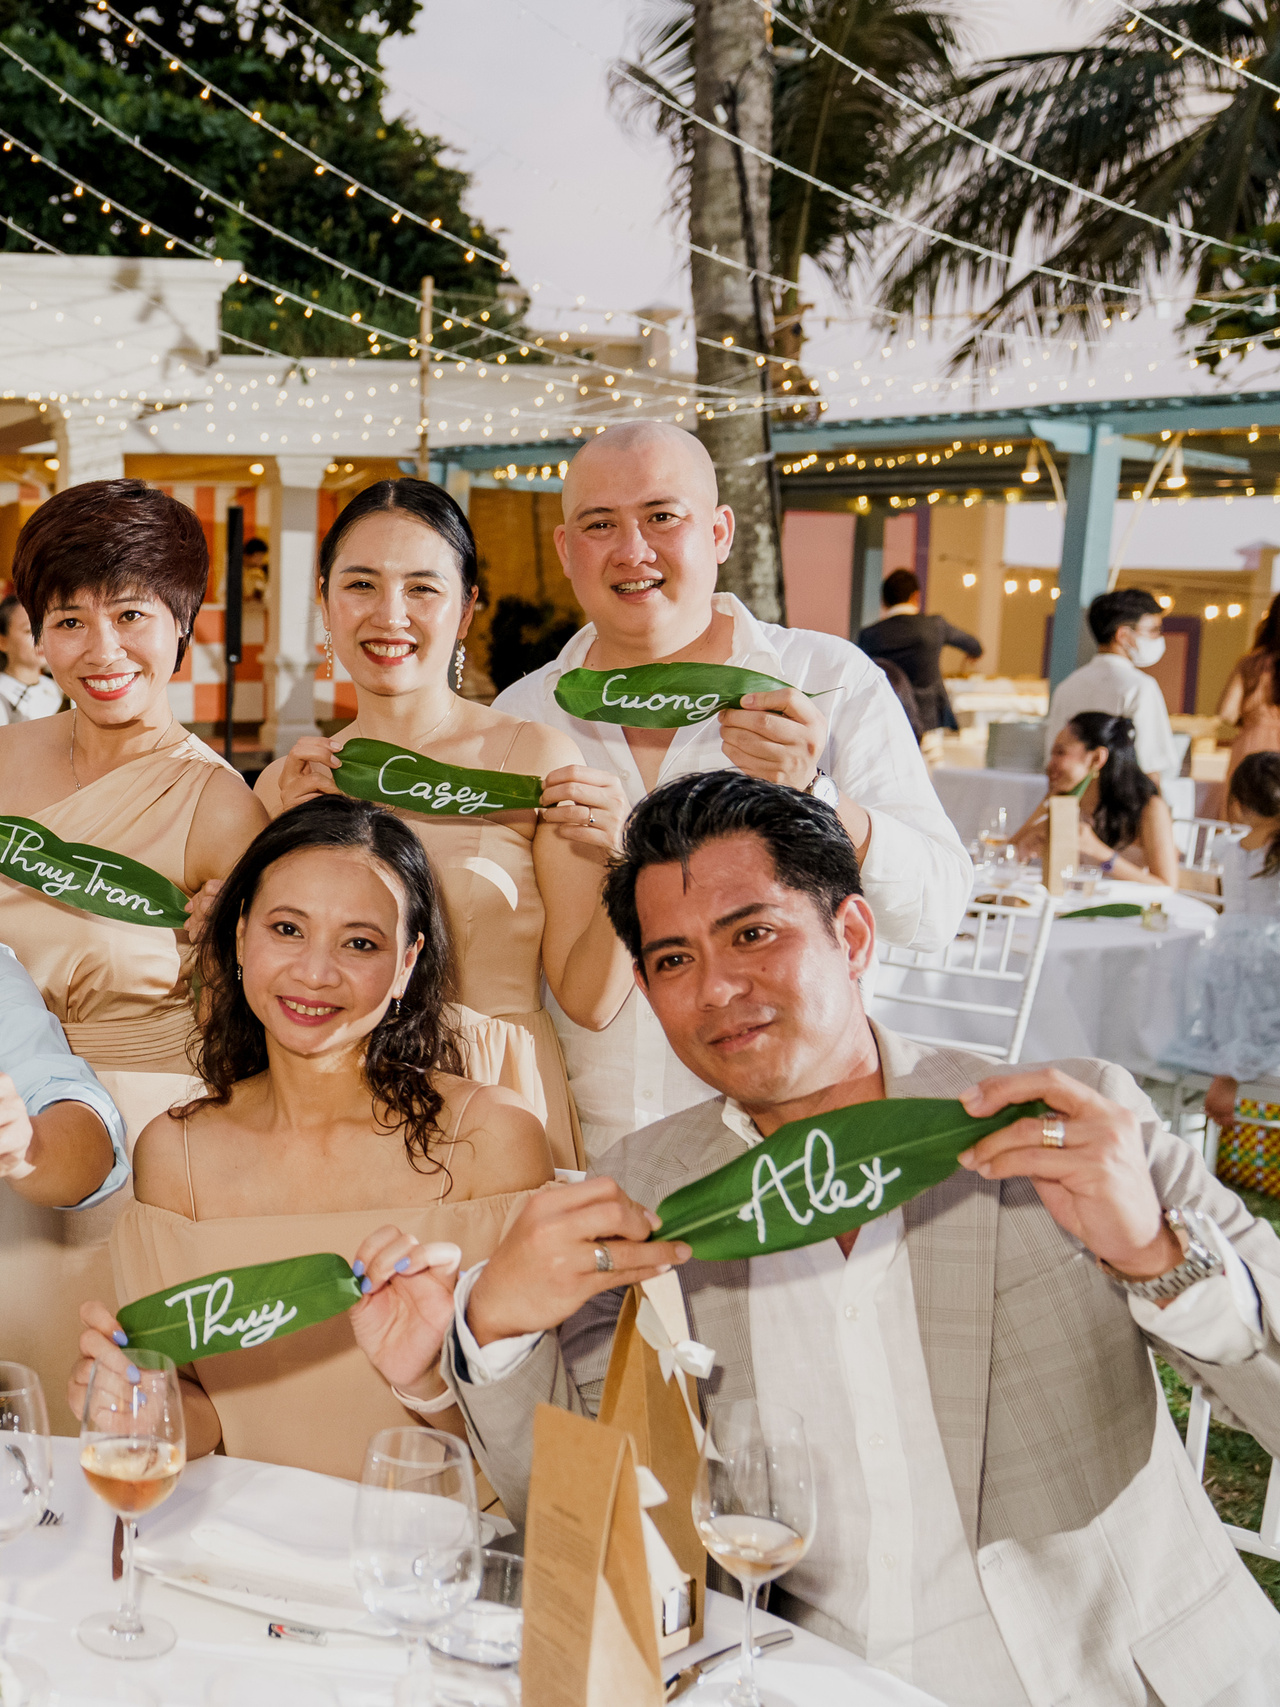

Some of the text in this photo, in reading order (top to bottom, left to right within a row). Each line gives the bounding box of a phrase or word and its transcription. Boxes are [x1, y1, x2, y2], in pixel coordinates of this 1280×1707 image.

[602, 673, 729, 721] Cuong
[378, 754, 504, 814] Casey
[736, 1128, 902, 1243] Alex
[164, 1276, 298, 1350] Thuy
